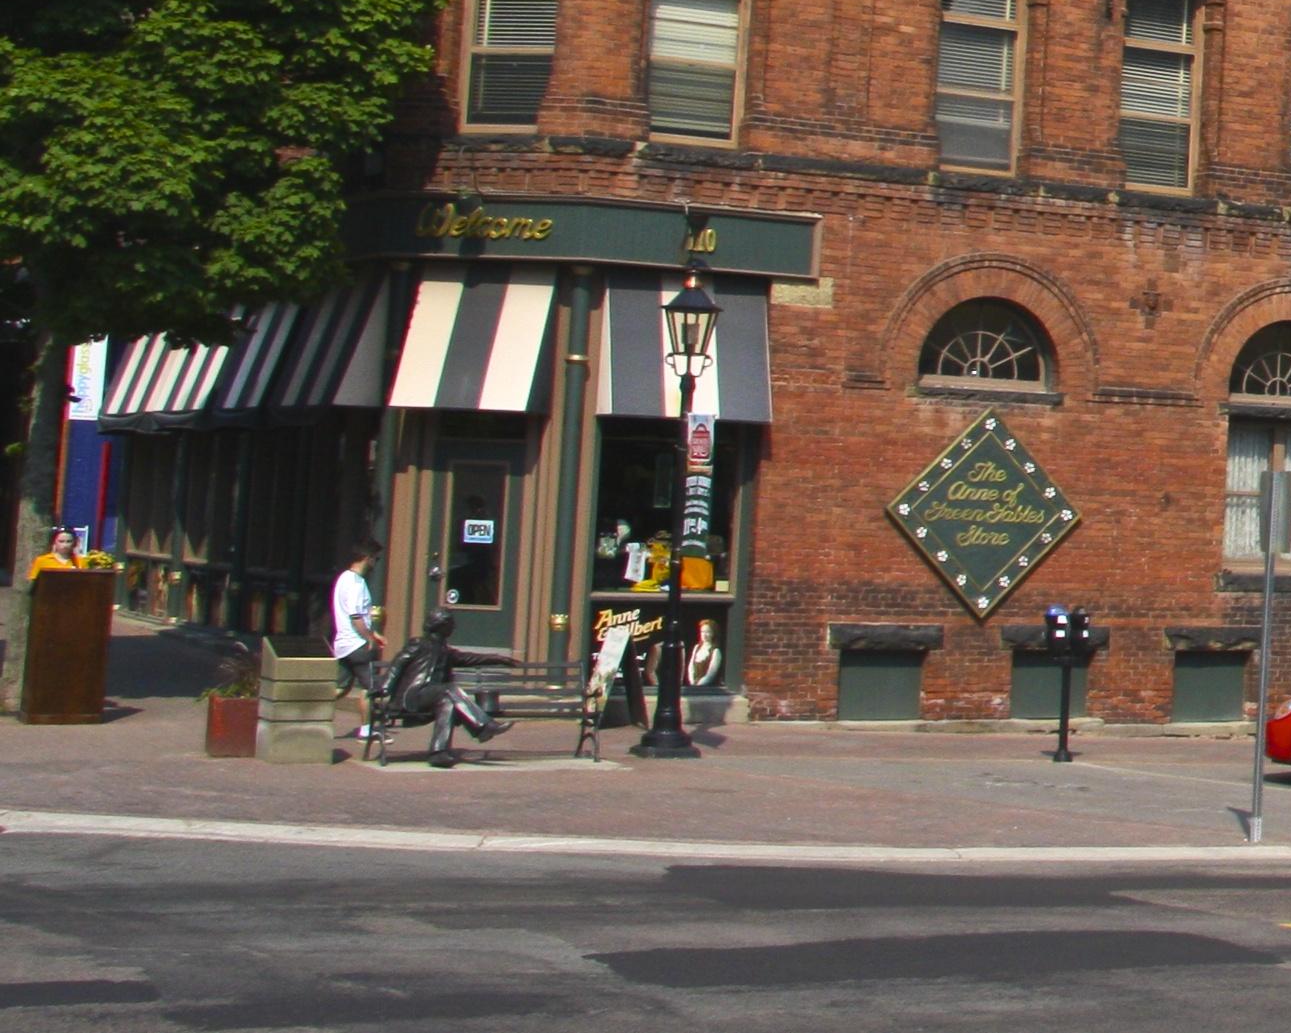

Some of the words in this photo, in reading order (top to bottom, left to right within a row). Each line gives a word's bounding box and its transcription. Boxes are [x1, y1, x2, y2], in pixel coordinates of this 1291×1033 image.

[416, 203, 553, 240] Welcome
[968, 462, 1007, 482] The
[948, 481, 1000, 501] Anne
[1002, 482, 1025, 508] of
[924, 501, 986, 522] Green
[985, 503, 1045, 524] Gables
[467, 524, 491, 537] OPEN
[956, 525, 1010, 547] Store
[595, 608, 641, 630] Anne
